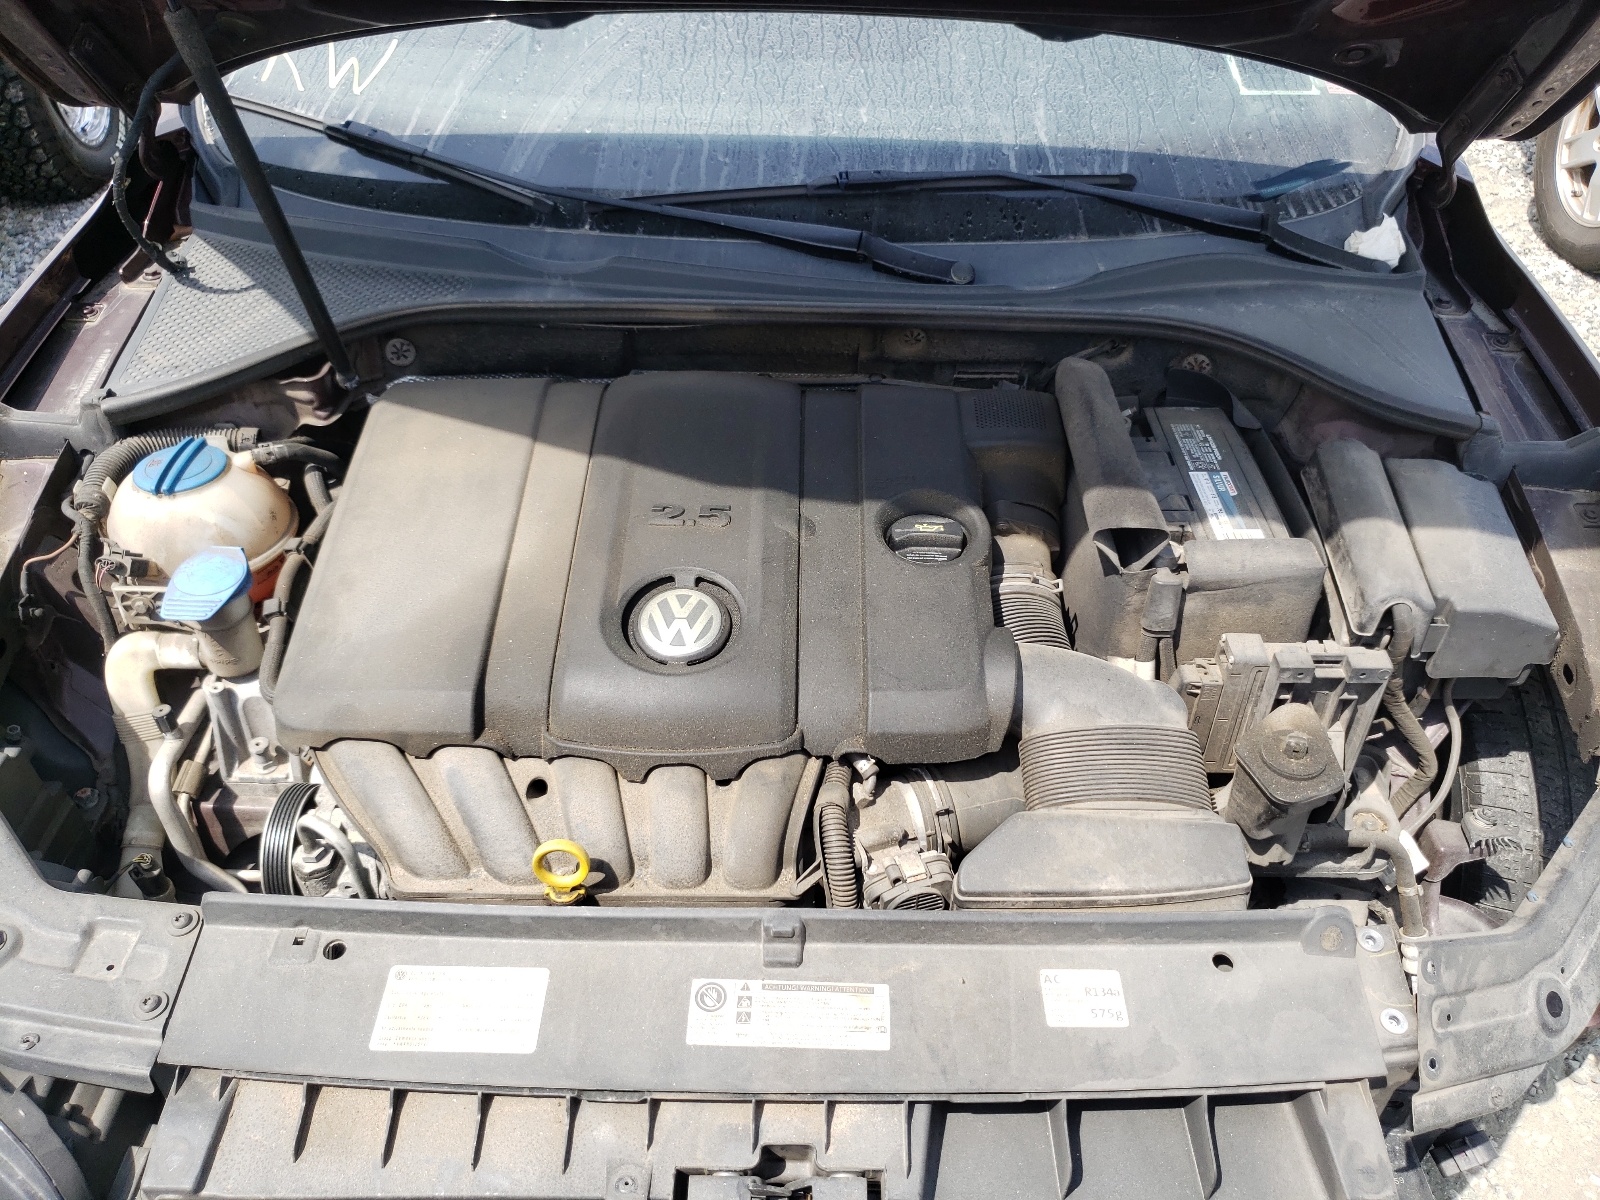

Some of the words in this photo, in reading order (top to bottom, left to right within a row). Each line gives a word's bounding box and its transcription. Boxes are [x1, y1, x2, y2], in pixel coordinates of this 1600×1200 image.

[648, 504, 732, 528] 2.5
[1043, 974, 1060, 984] AC
[1084, 987, 1120, 997] R134a
[1090, 1008, 1124, 1022] 575g
